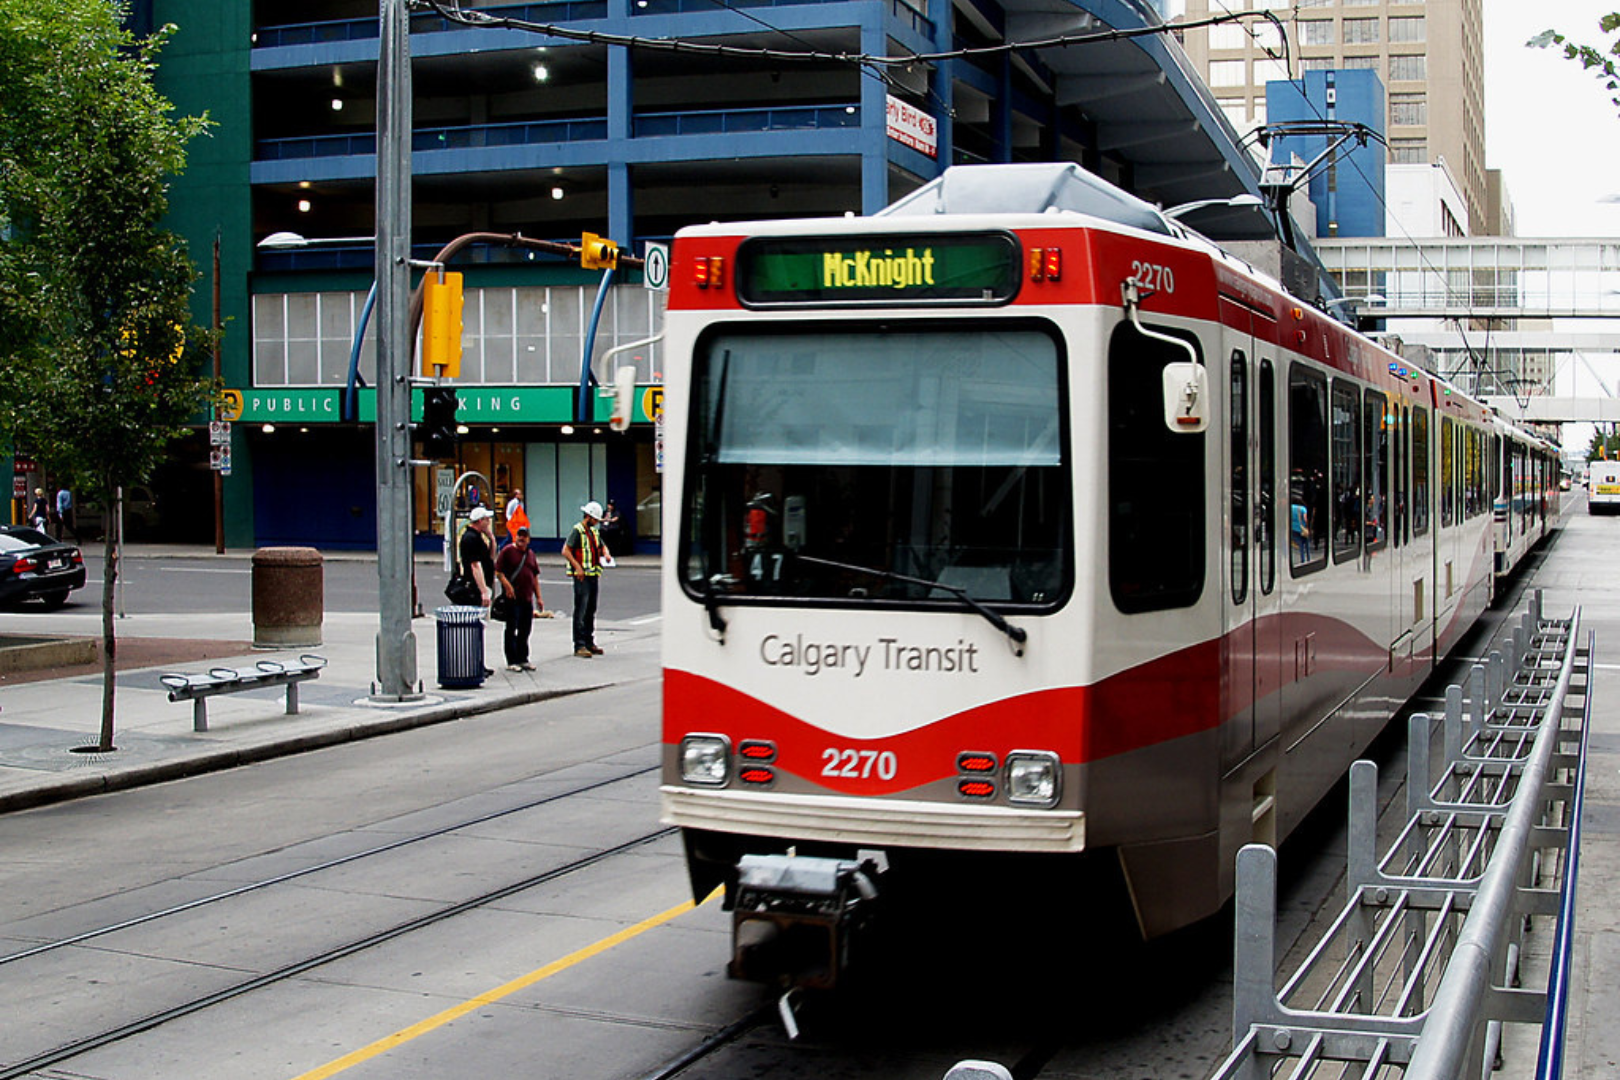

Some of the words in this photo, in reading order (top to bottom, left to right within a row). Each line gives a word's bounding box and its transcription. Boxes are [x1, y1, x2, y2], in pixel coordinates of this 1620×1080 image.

[823, 247, 935, 289] McKnight
[1132, 260, 1174, 294] 2270
[252, 398, 332, 412] PUBLIC
[457, 397, 521, 411] KING
[760, 633, 871, 678] Calgary
[878, 637, 979, 673] Transit
[821, 746, 898, 781] 2270
